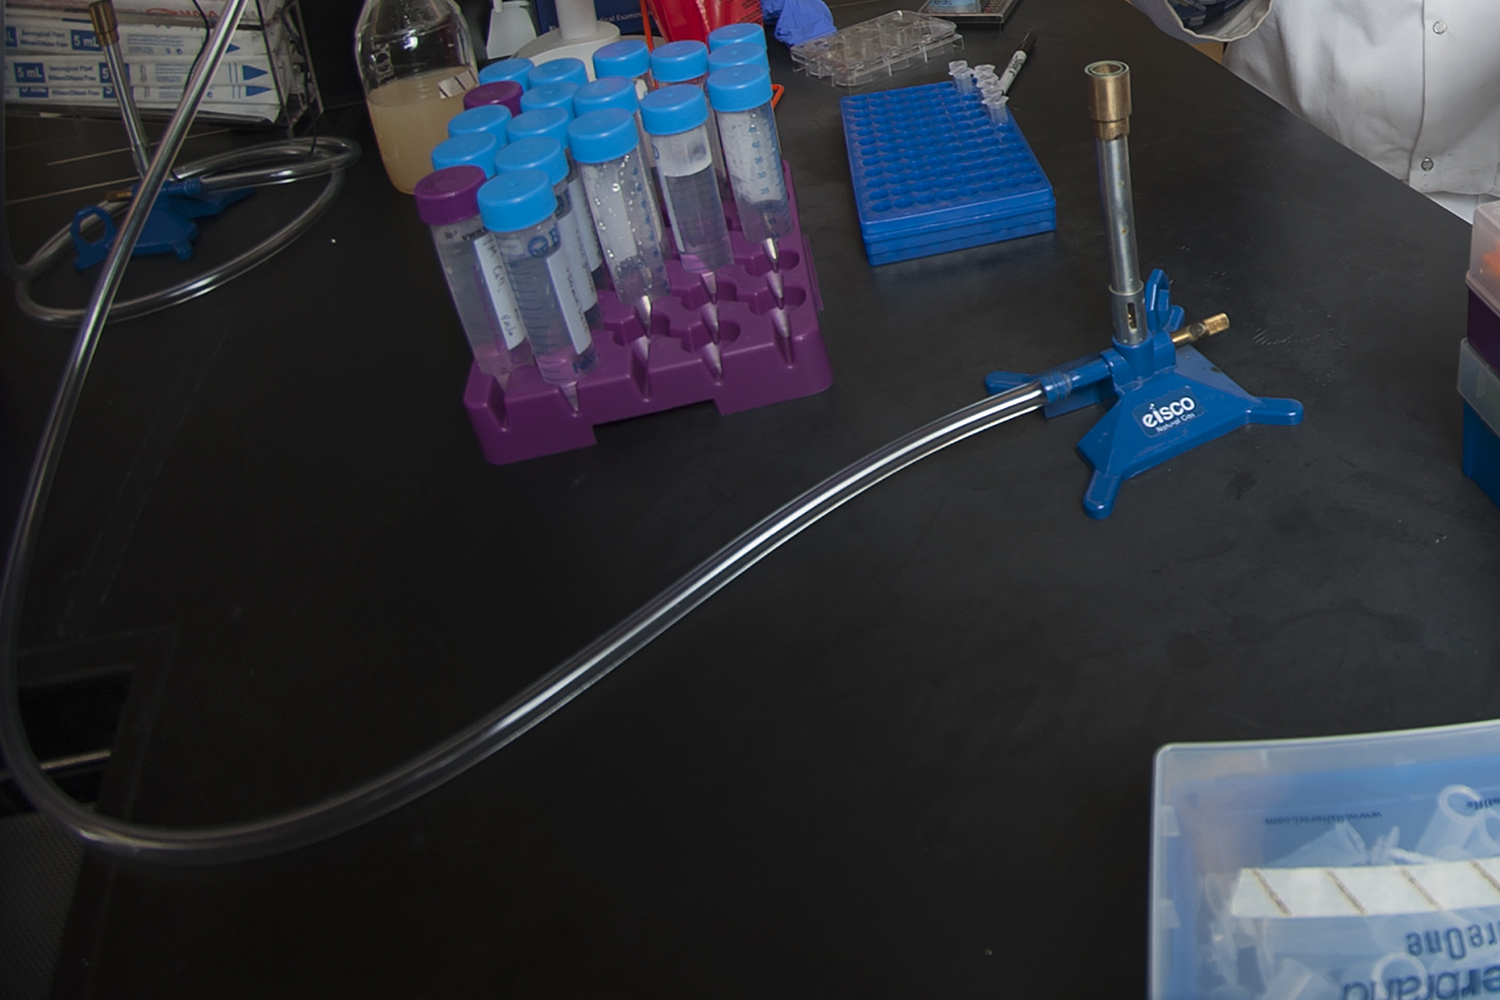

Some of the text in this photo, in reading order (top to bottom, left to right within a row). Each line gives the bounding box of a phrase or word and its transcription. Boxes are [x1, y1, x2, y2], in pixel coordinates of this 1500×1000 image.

[74, 36, 99, 46] 5 mL
[17, 67, 43, 78] 5 mL
[101, 68, 108, 79] 5
[1142, 397, 1196, 428] eisco
